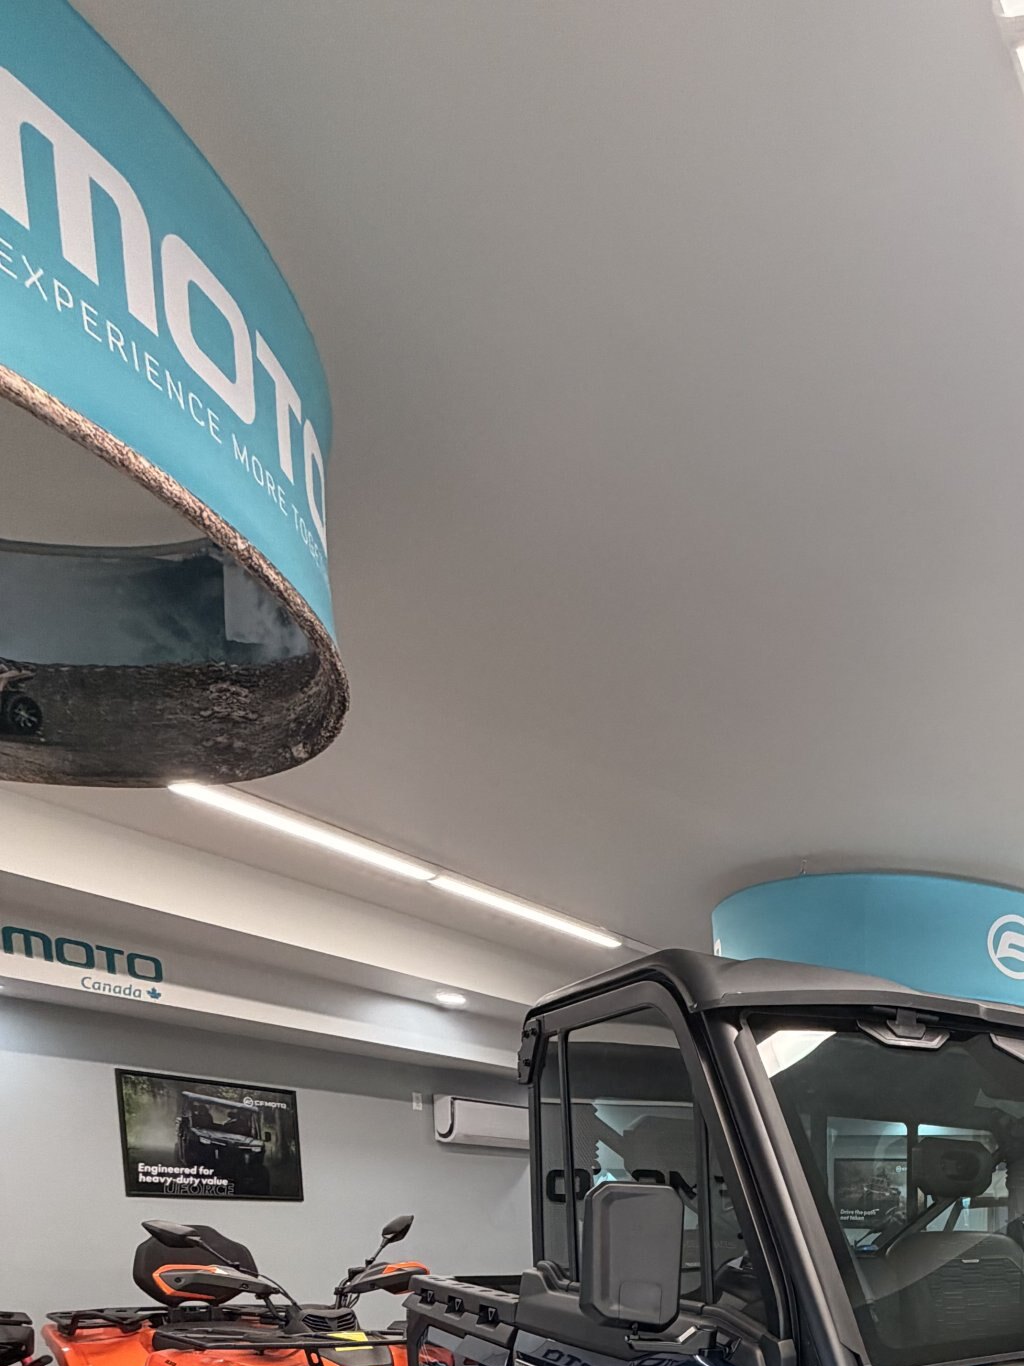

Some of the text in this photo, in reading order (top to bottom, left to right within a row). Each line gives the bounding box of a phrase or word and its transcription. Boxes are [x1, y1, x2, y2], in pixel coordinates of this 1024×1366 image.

[0, 236, 222, 444] EXPERIENCE
[231, 432, 288, 517] MORE
[1, 926, 163, 983] MOTO
[81, 976, 142, 999] Canada
[254, 1100, 287, 1109] CFMOTO
[138, 1163, 214, 1176] Engineered for
[139, 1174, 201, 1186] heavy-duty
[163, 1182, 235, 1195] UFORCE
